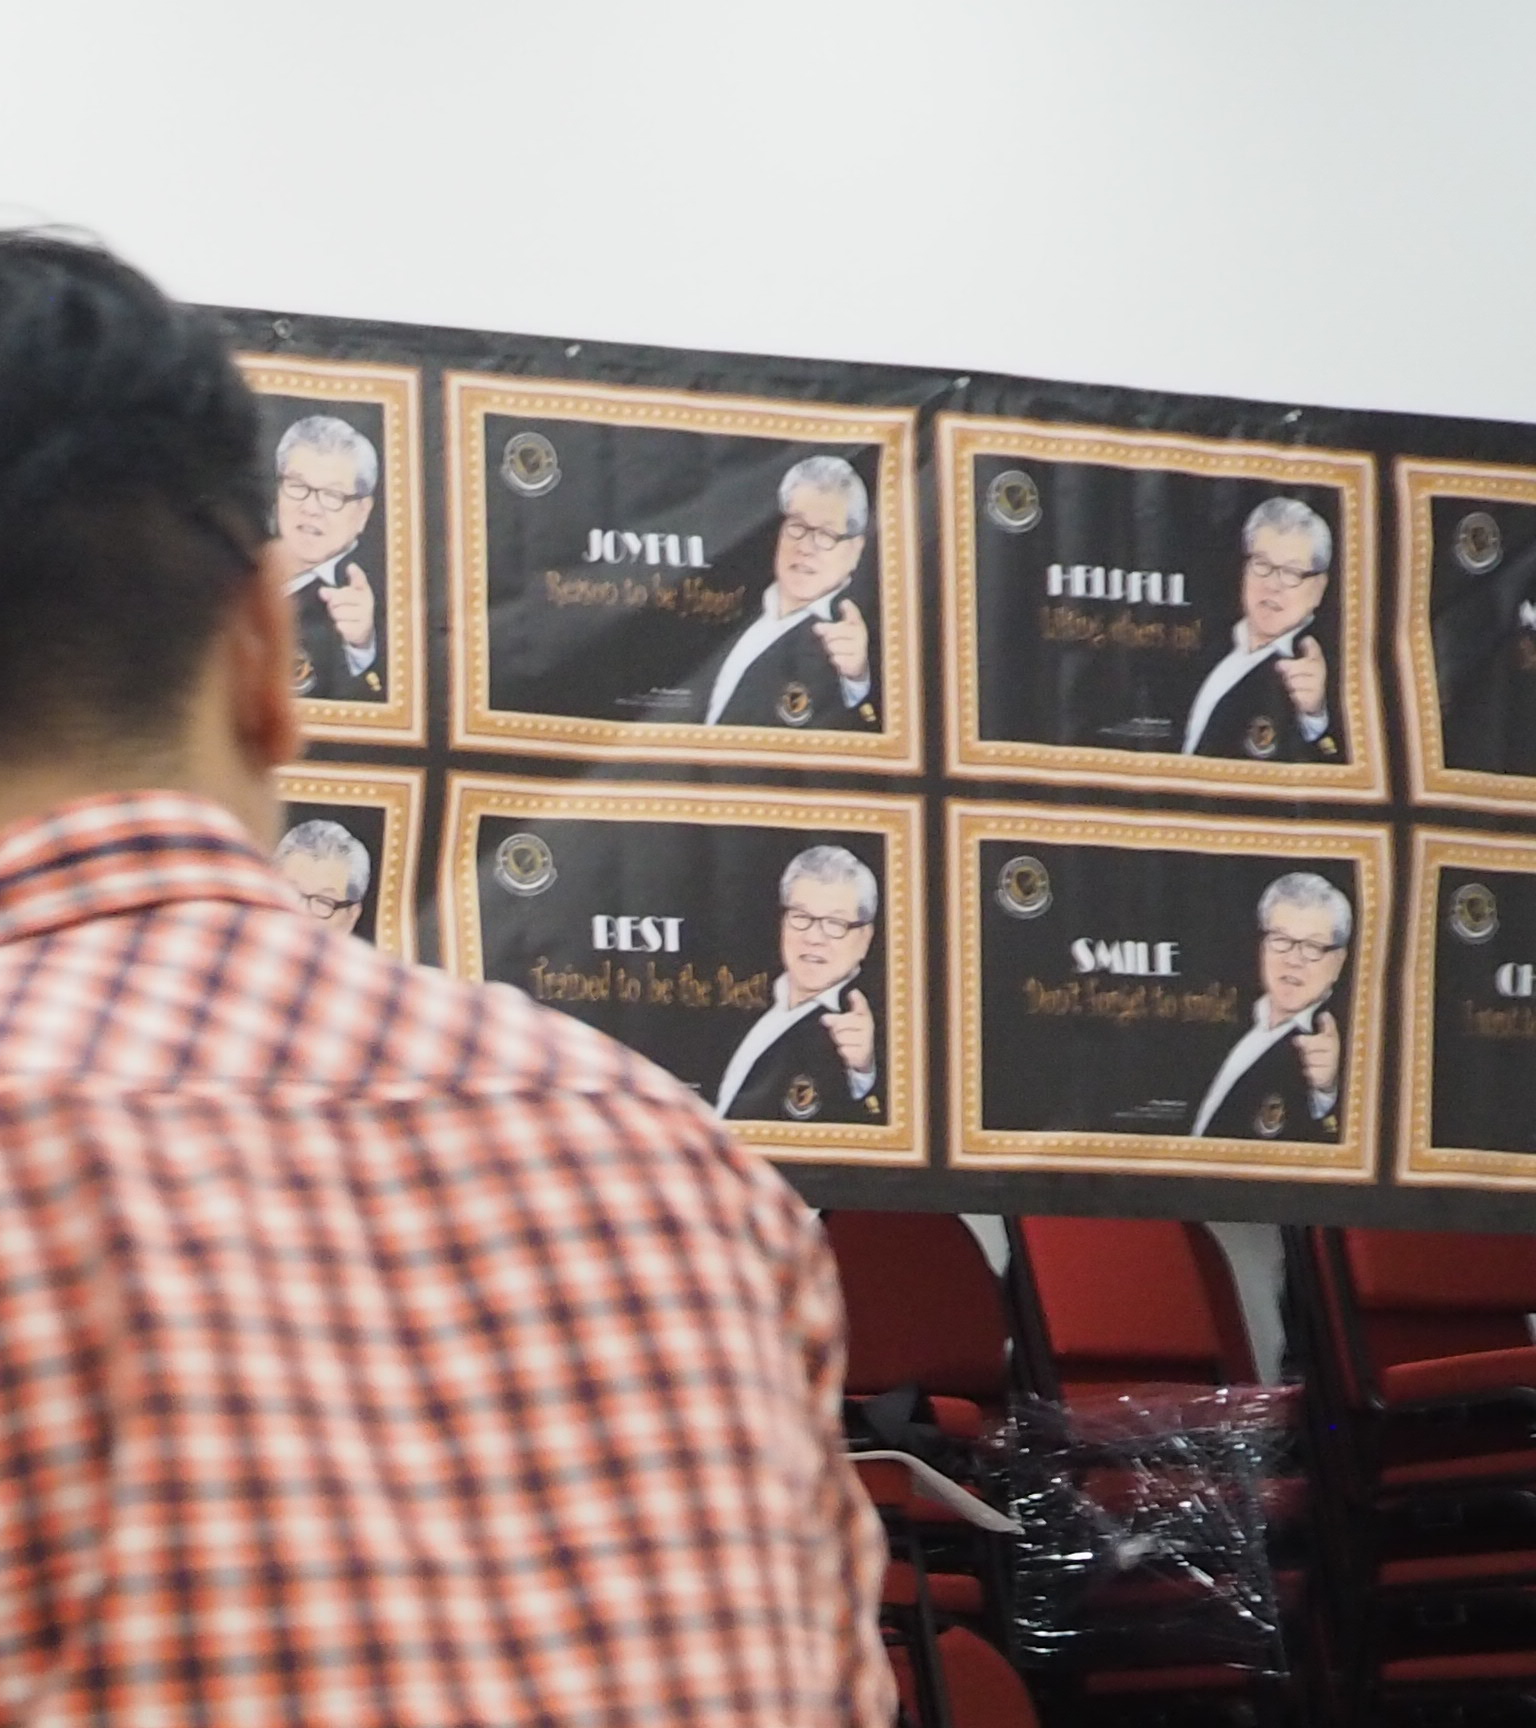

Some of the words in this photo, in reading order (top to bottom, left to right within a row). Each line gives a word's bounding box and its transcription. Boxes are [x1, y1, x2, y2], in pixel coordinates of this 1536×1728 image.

[582, 528, 713, 567] JOYFUL
[591, 913, 685, 953] BEST
[1071, 936, 1182, 976] SMILE
